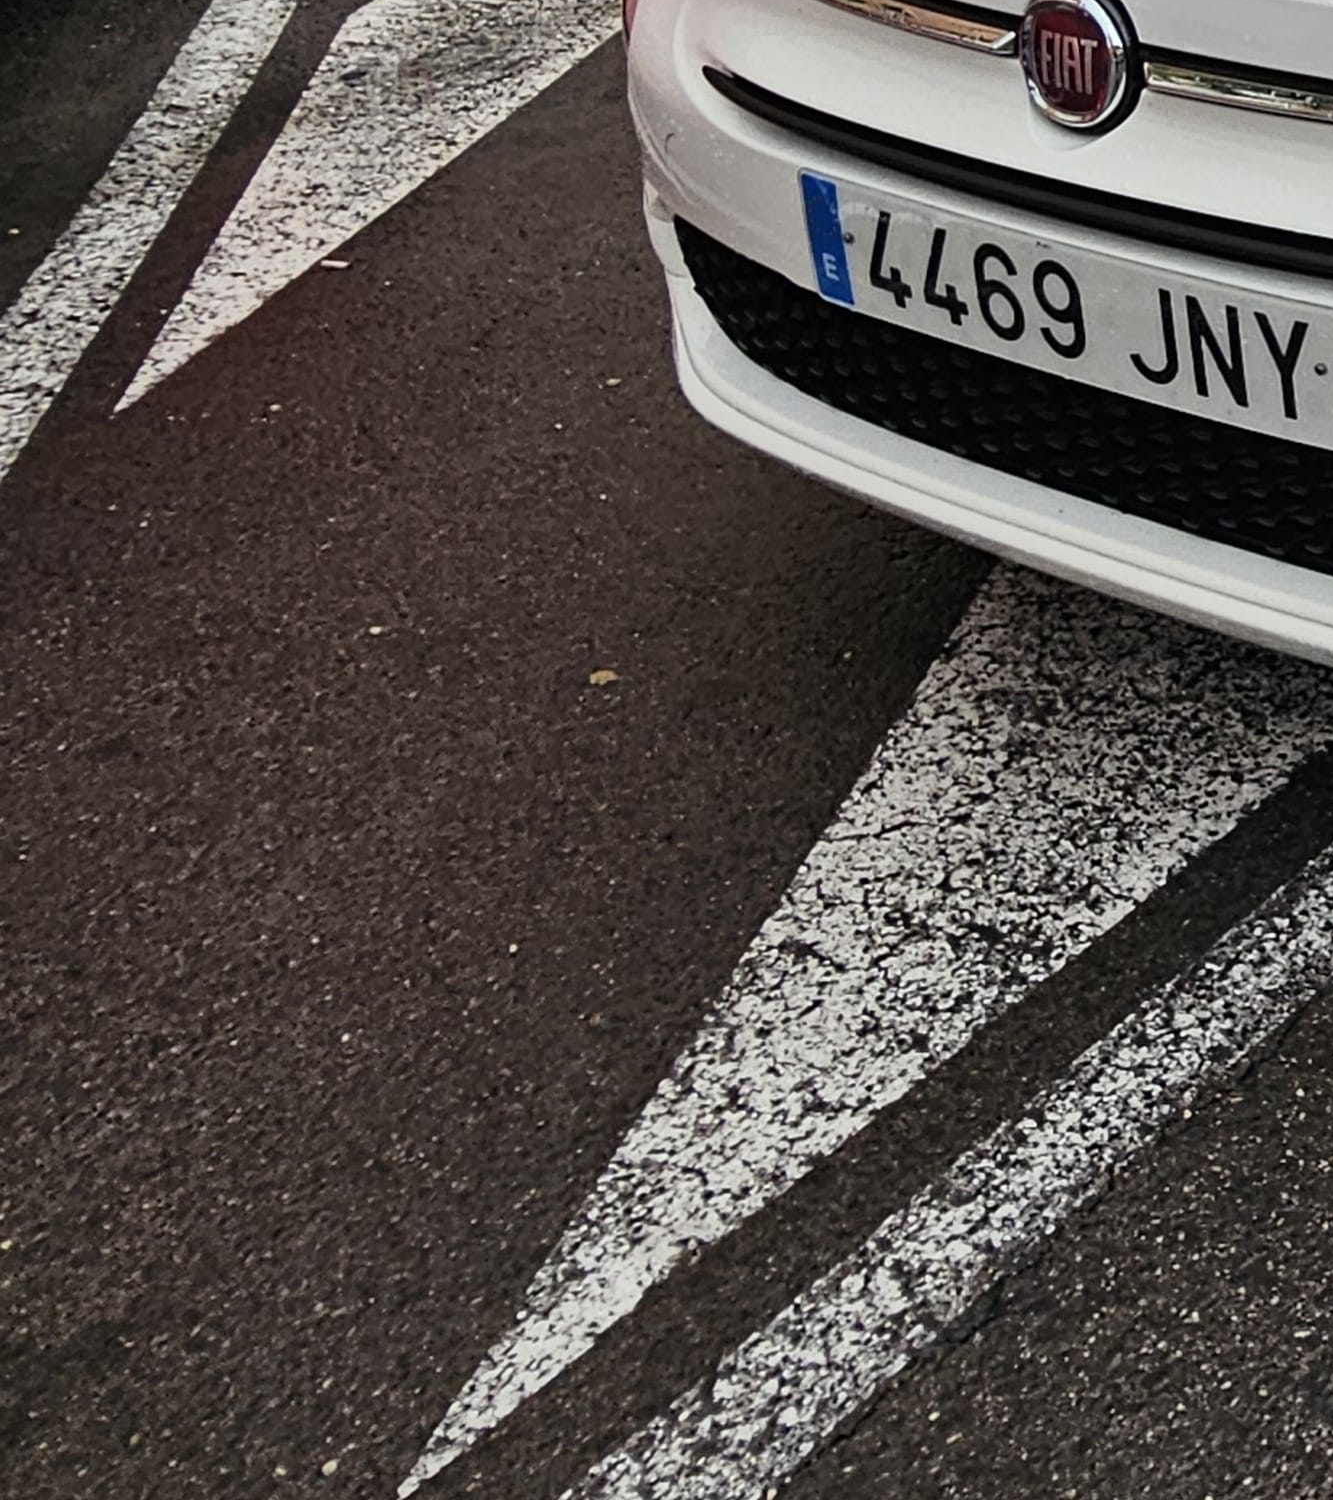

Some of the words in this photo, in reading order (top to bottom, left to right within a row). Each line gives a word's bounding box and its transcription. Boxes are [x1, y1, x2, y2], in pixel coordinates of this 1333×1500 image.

[1039, 28, 1099, 96] FIAT
[822, 251, 840, 282] E
[867, 210, 1087, 360] 4469
[1129, 287, 1310, 421] JNY
